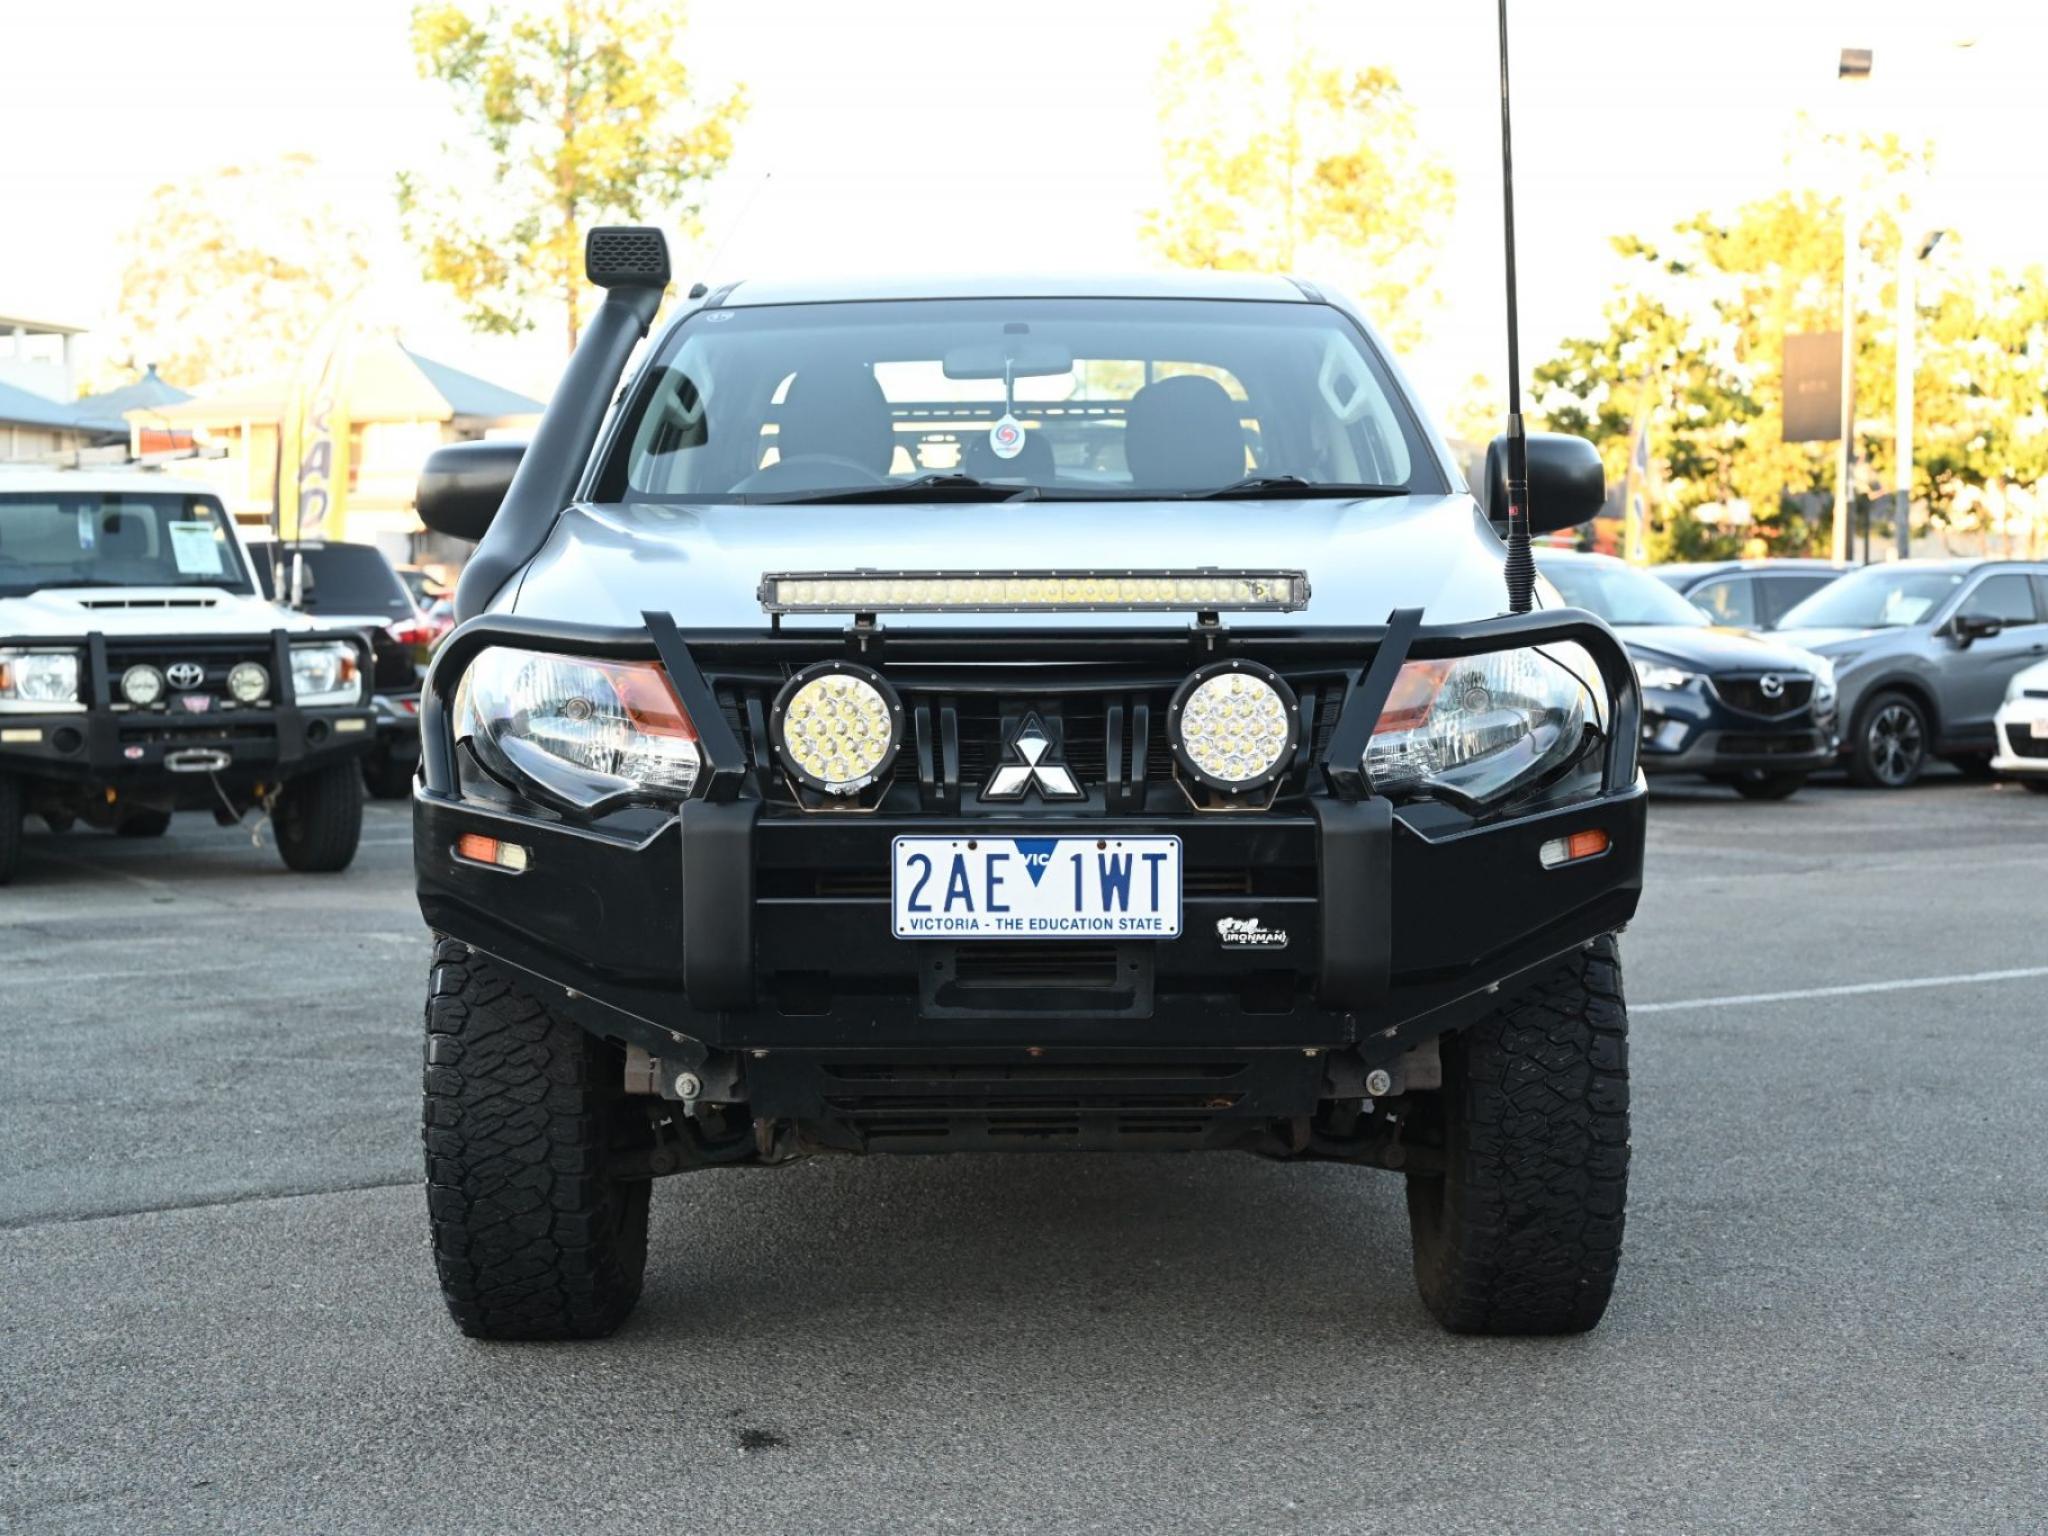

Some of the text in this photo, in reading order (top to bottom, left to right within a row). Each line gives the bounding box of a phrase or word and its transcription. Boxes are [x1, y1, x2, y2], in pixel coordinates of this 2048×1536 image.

[1021, 853, 1051, 867] VIC
[906, 853, 1168, 912] 2AE 1WT
[910, 917, 980, 931] VICTORIA
[995, 917, 1023, 931] THE
[1029, 917, 1113, 931] EDUCATION
[1119, 917, 1162, 931] STATE
[1226, 933, 1284, 942] IRONMAN
